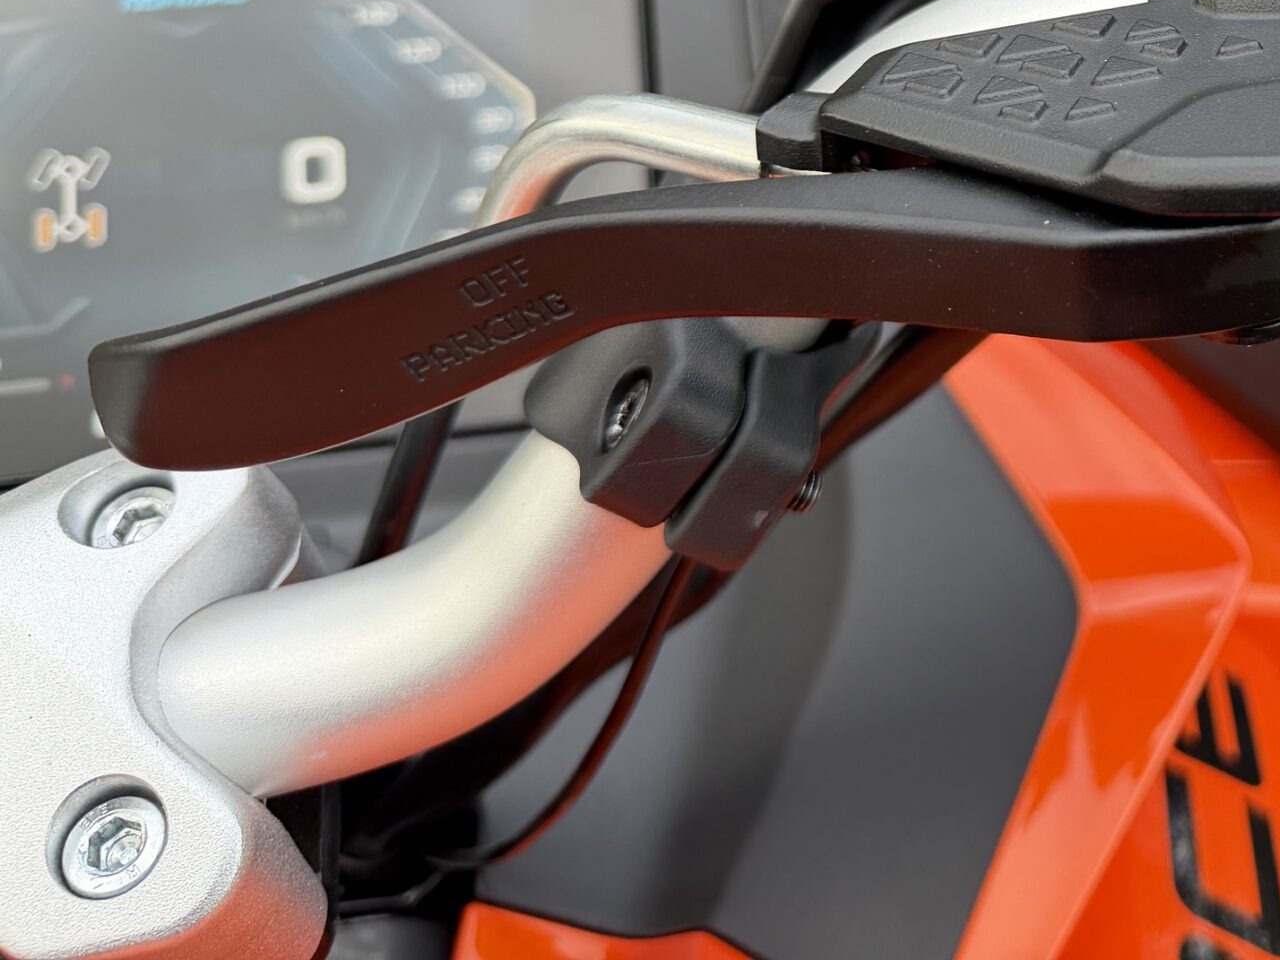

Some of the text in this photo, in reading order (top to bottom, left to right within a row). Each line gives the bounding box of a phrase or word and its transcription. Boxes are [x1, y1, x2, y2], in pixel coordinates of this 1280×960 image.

[281, 135, 347, 205] 0
[459, 255, 529, 307] OFF
[400, 290, 574, 383] PARKING
